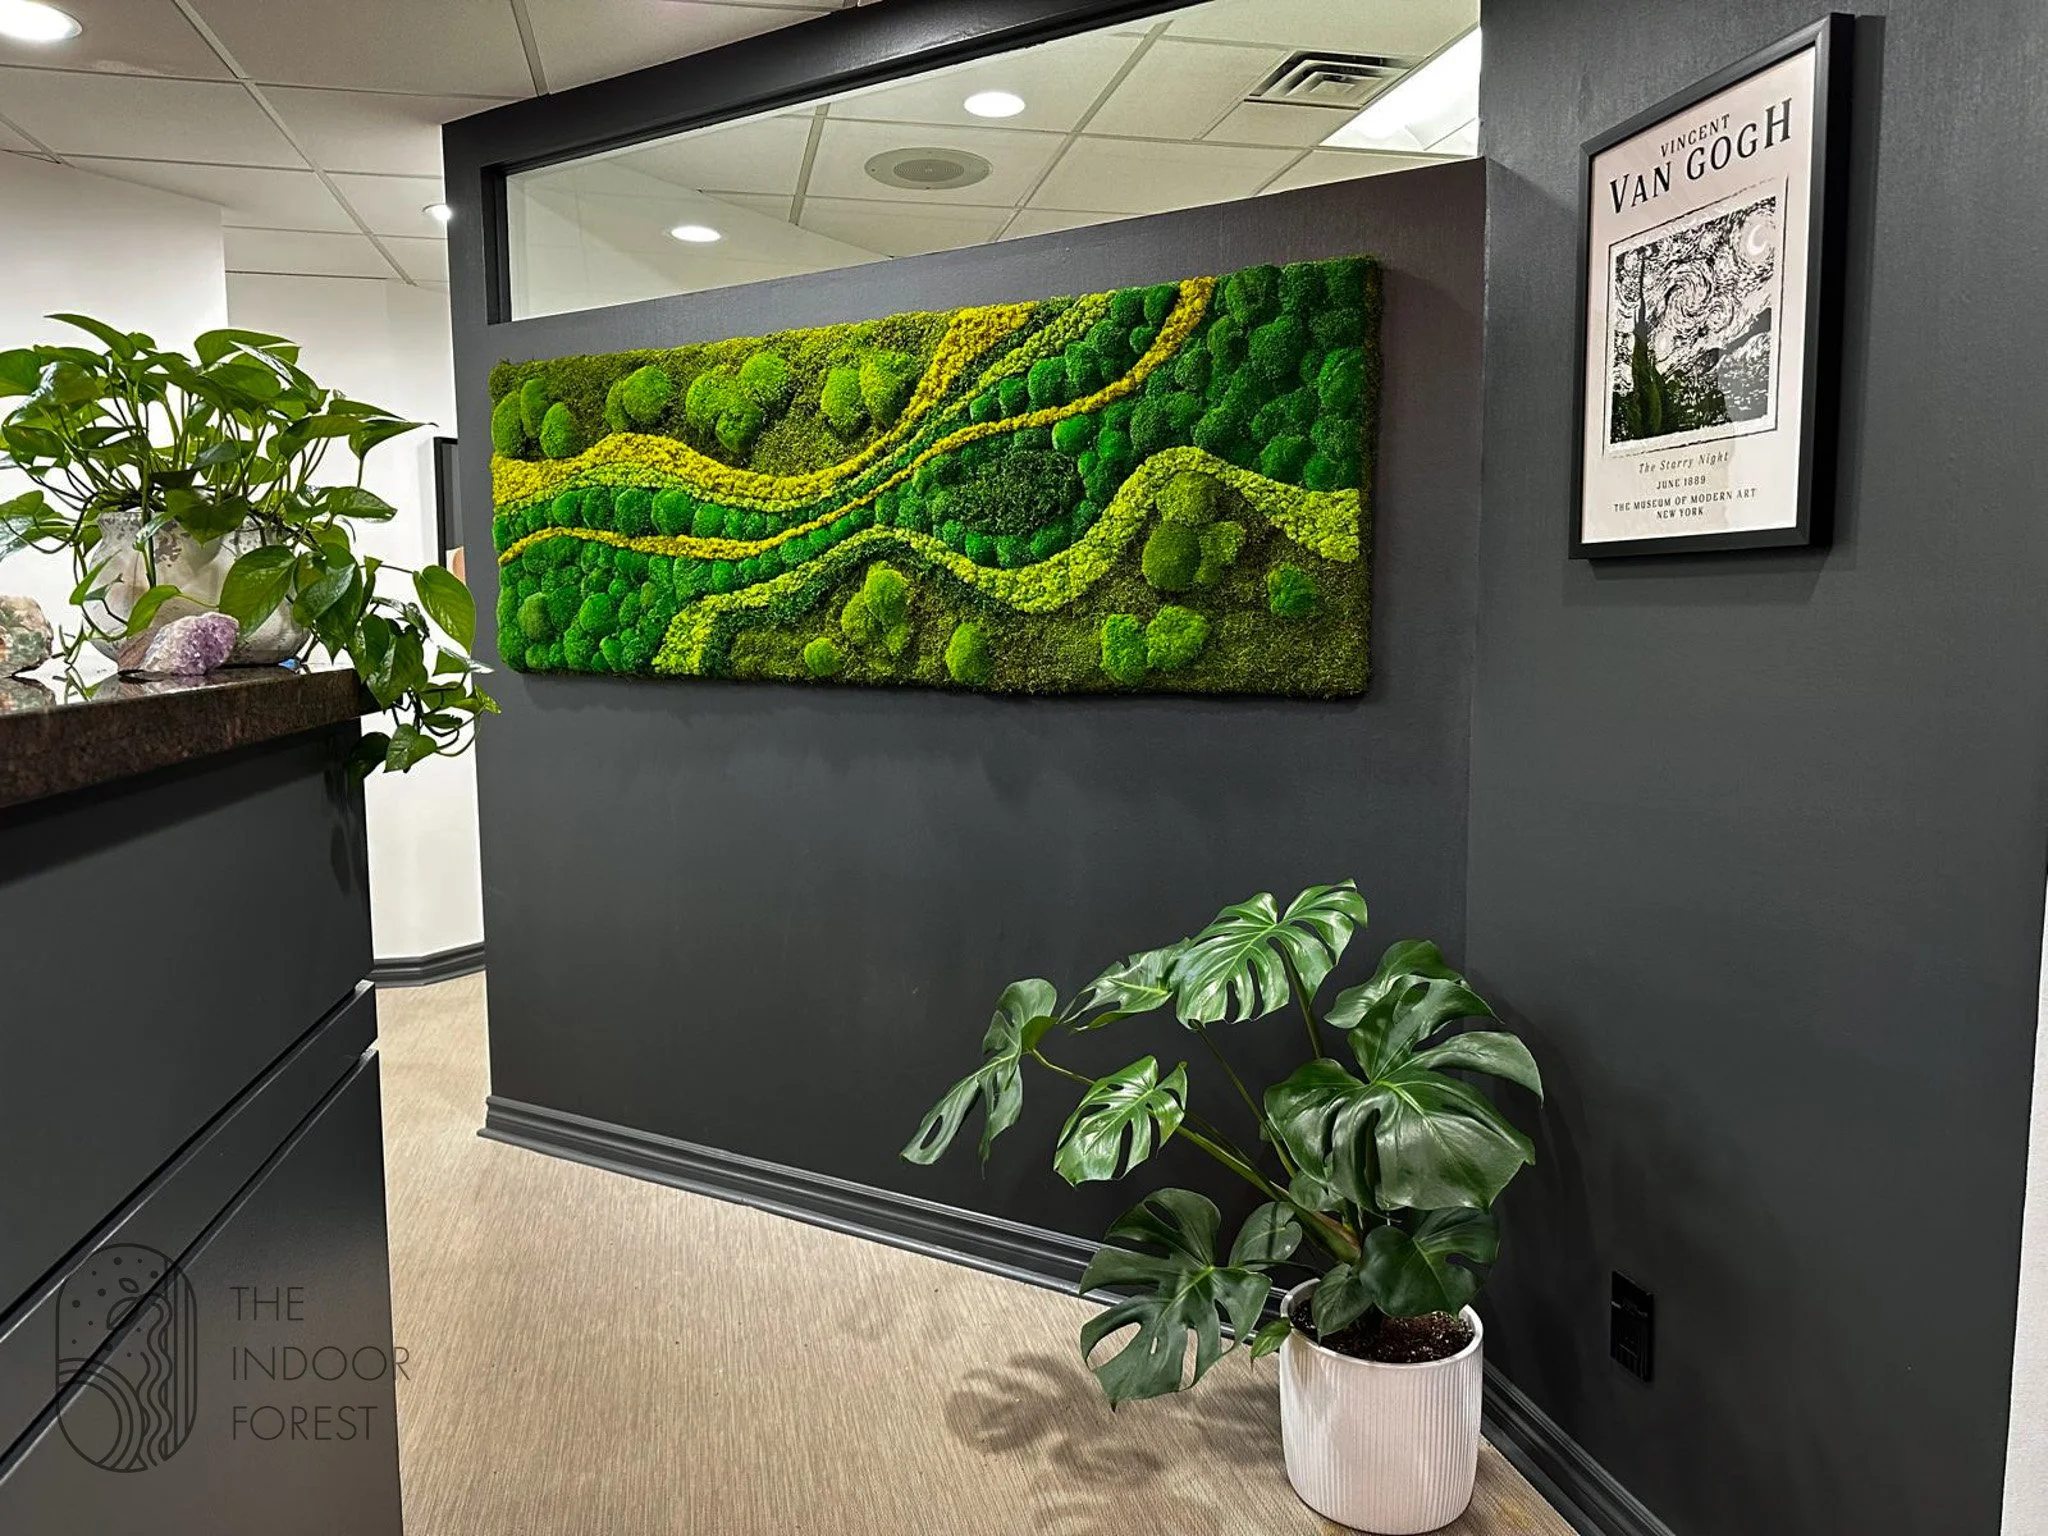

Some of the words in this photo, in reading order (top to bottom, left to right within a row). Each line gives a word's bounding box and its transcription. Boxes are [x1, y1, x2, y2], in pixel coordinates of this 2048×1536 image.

[1660, 113, 1730, 158] VINCENT
[1610, 161, 1671, 214] VAN
[1686, 97, 1792, 180] GOGH
[1639, 462, 1656, 474] The
[1660, 458, 1694, 471] Starry
[1698, 451, 1729, 466] Night
[1656, 478, 1681, 490] JUNE
[1684, 475, 1706, 487] 1889
[1614, 501, 1631, 512] THE
[1634, 498, 1671, 510] MUSEUM
[1675, 495, 1687, 506] OF
[1691, 490, 1733, 504] MODERN
[1736, 487, 1757, 499] ART
[1656, 509, 1676, 519] NEW
[1679, 506, 1704, 518] YORK
